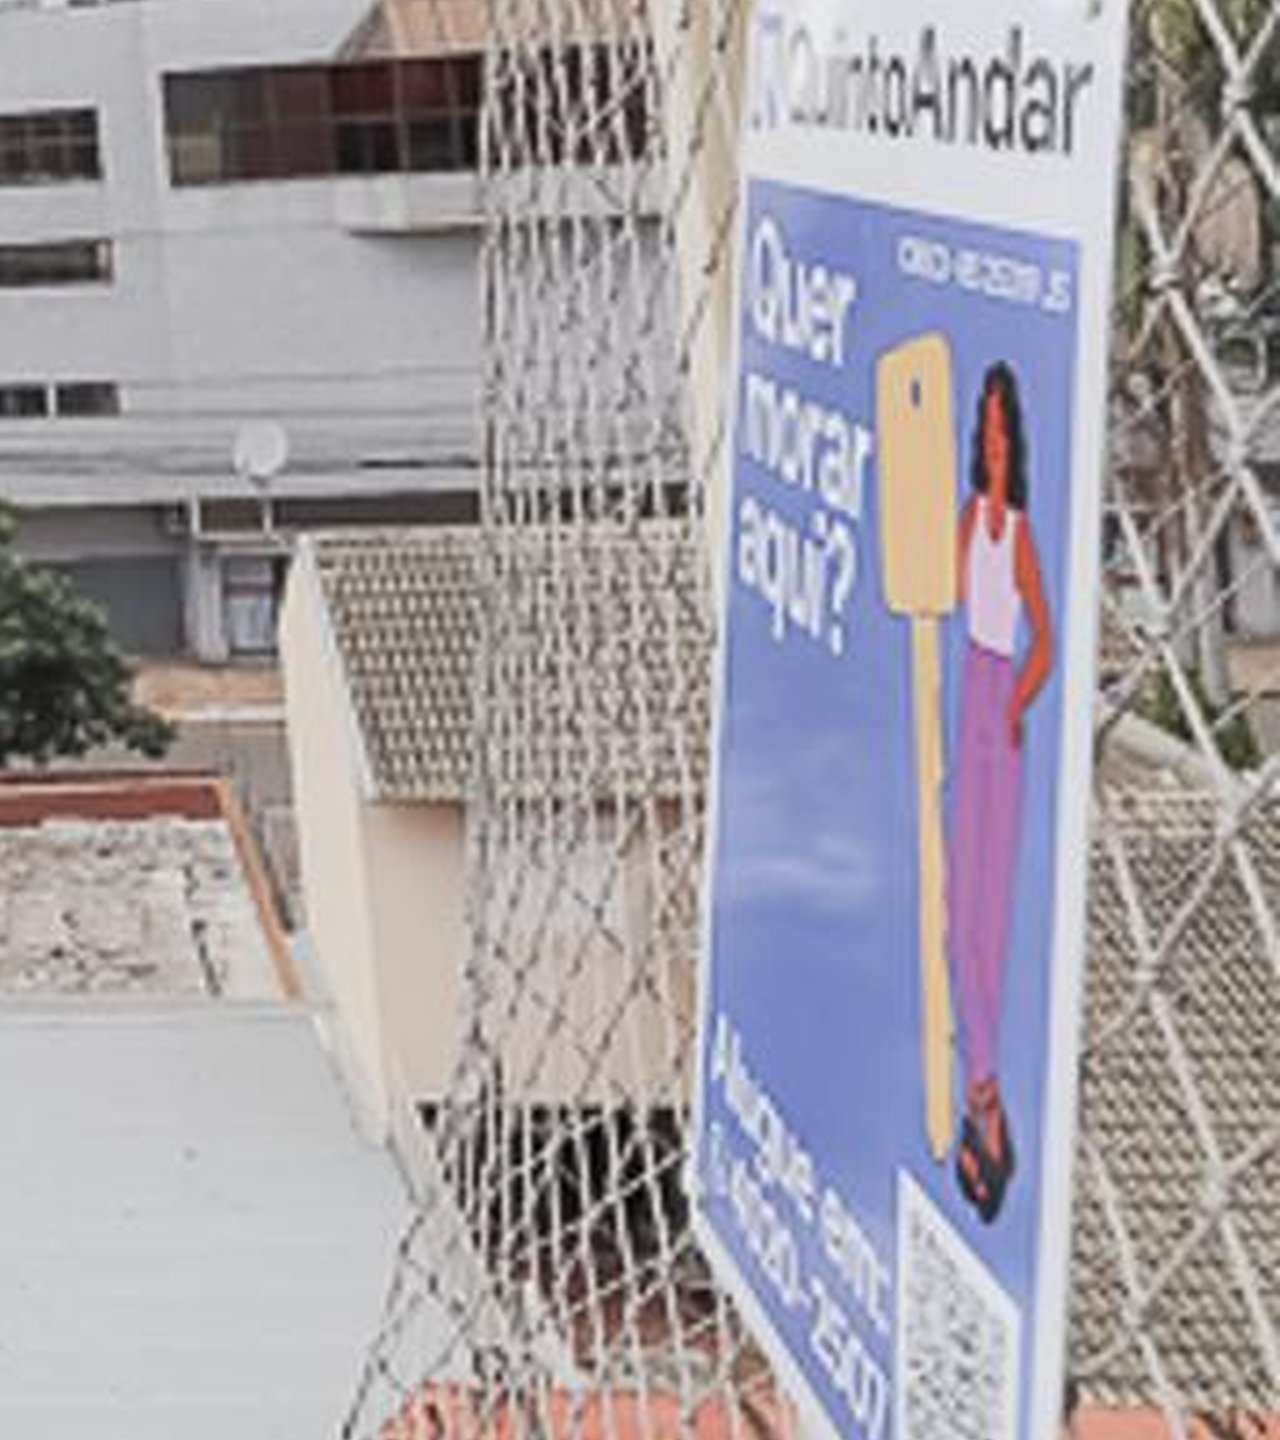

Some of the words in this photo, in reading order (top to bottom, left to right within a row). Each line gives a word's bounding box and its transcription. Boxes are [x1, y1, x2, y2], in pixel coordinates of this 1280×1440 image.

[752, 216, 857, 366] Quer
[743, 372, 872, 520] morar
[739, 496, 856, 657] aqui?
